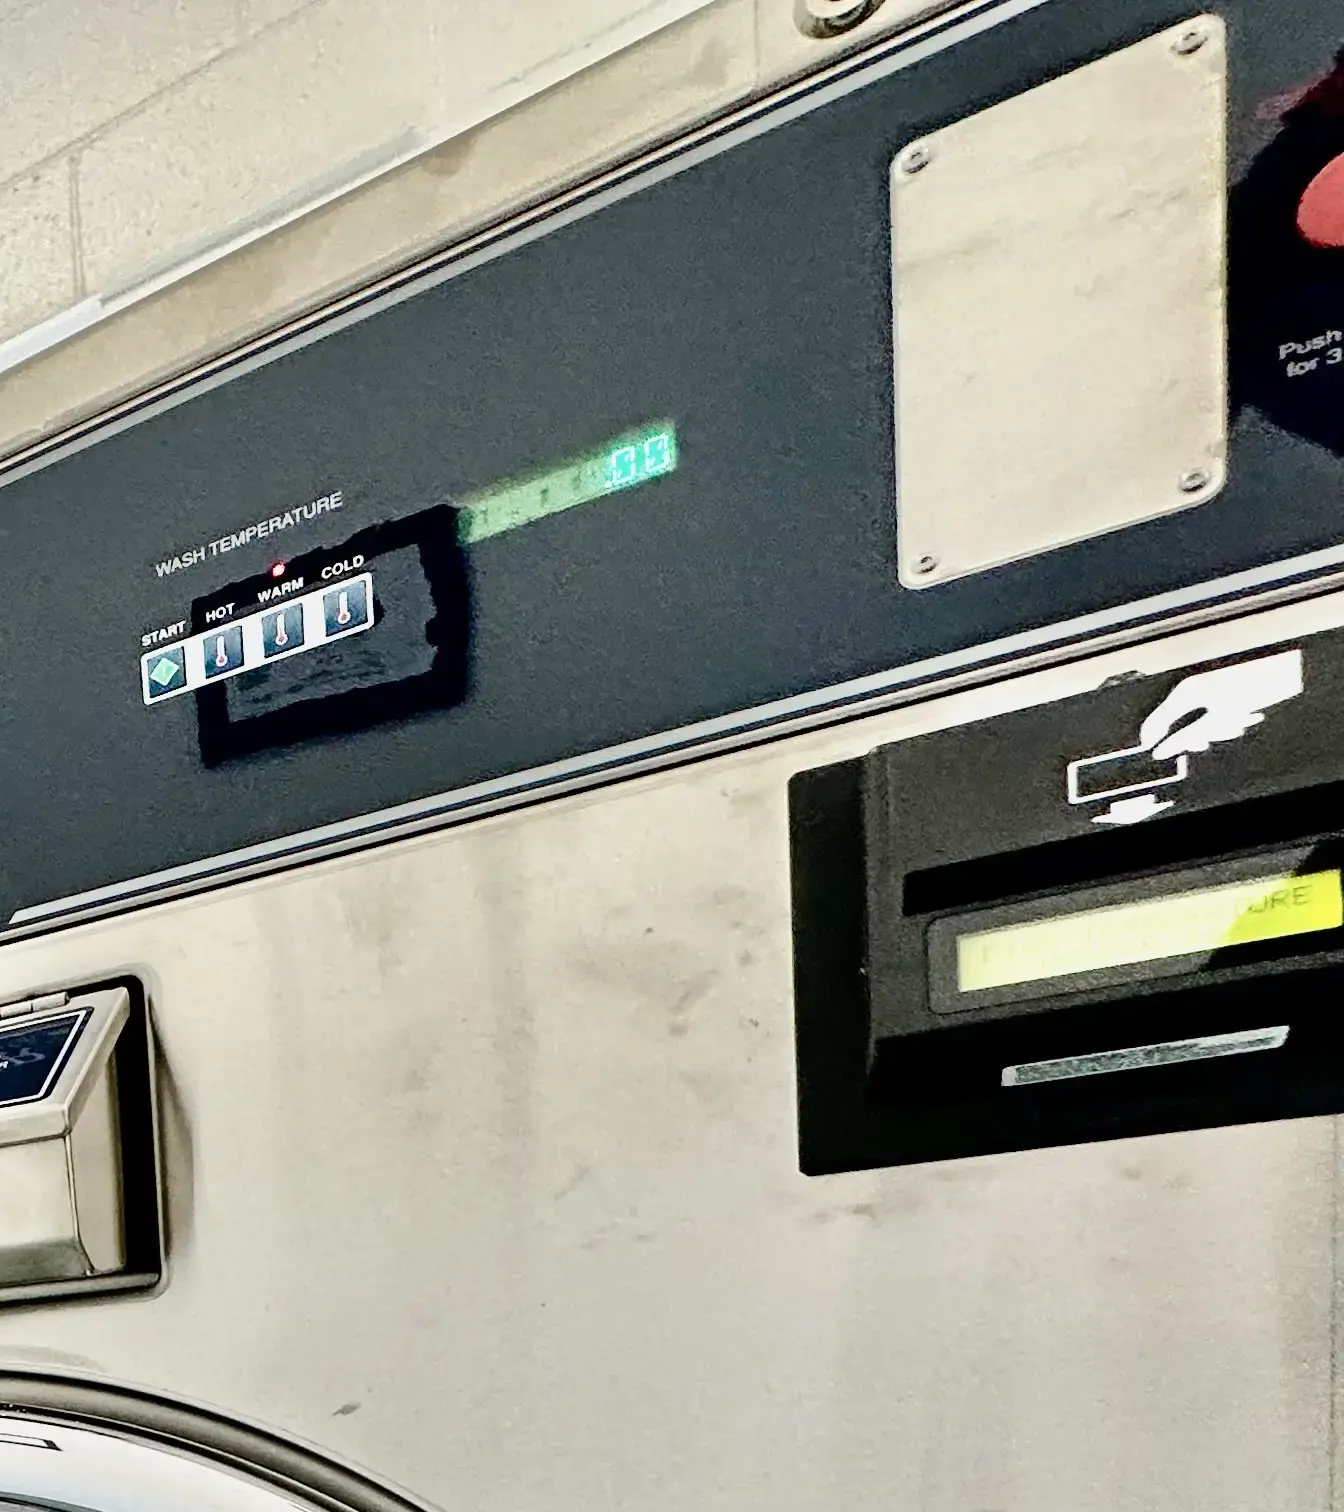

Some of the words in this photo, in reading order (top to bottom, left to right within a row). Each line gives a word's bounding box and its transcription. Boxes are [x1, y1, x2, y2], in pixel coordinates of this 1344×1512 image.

[1278, 330, 1343, 361] Push
[1325, 347, 1343, 365] 3
[155, 547, 206, 578] WASH
[209, 491, 343, 557] TEMPERATURE
[321, 555, 365, 580] COLD
[257, 577, 304, 603] WARM
[206, 603, 235, 624] HOT
[141, 621, 186, 647] START
